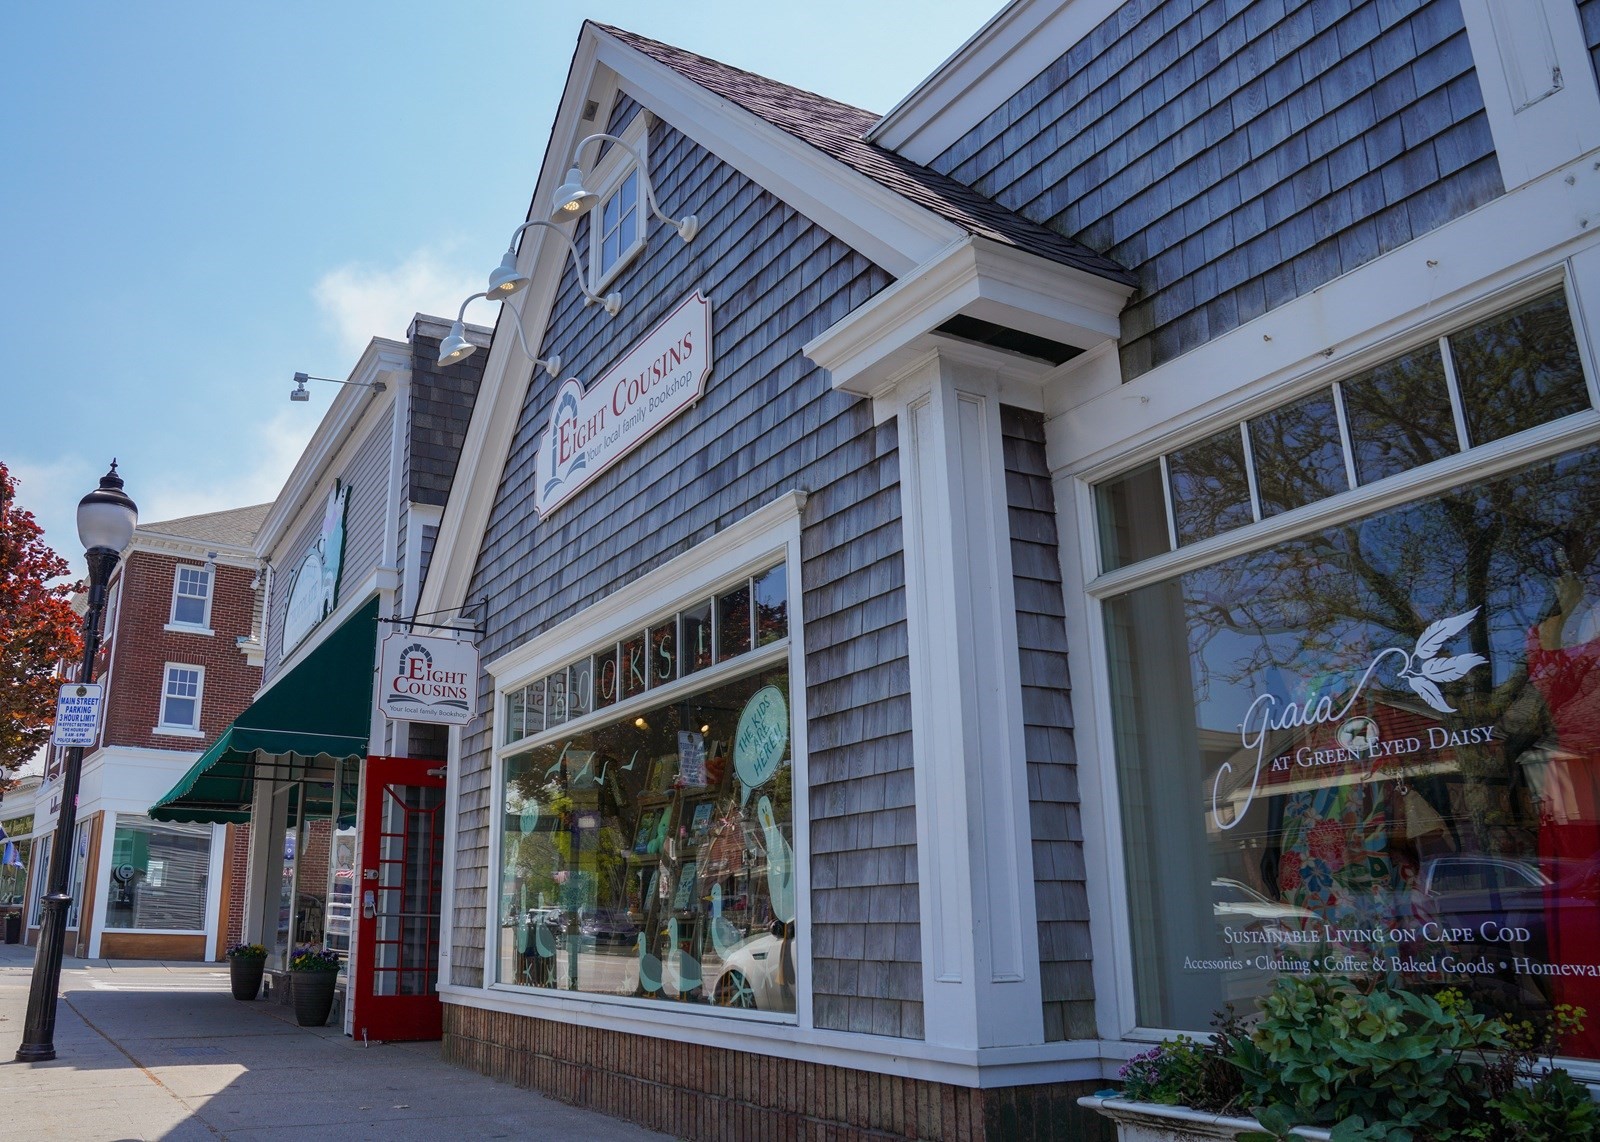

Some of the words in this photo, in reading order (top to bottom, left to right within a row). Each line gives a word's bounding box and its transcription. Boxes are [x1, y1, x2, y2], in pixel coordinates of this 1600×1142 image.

[558, 405, 607, 467] EIGHT
[612, 331, 693, 416] COUSINS
[586, 443, 602, 462] Your
[604, 424, 620, 449] local
[622, 406, 647, 434] family
[649, 371, 693, 412] Bookshop
[409, 657, 467, 685] EIGHT
[393, 676, 467, 699] COUSINS
[64, 714, 79, 722] HOUR
[420, 708, 438, 716] family
[439, 710, 467, 719] Bookshop
[739, 725, 754, 752] THE
[751, 694, 771, 729] KIDS
[753, 719, 770, 753] ARE
[1271, 756, 1291, 771] AT
[1296, 745, 1360, 768] GREEN
[1367, 736, 1421, 758] EYED
[1427, 726, 1495, 749] DAISY
[1224, 926, 1320, 944] SUSTAINABLE
[1324, 924, 1384, 943] LIVING
[1390, 927, 1416, 943] ON
[1422, 922, 1475, 943] CAPE
[1480, 921, 1531, 943] COD
[1183, 956, 1243, 970] Accessories
[1255, 955, 1310, 975] Clothing
[1323, 955, 1368, 971] Coffee
[1372, 957, 1387, 972] &
[1392, 956, 1437, 973] Baked
[1441, 956, 1495, 974] Goods
